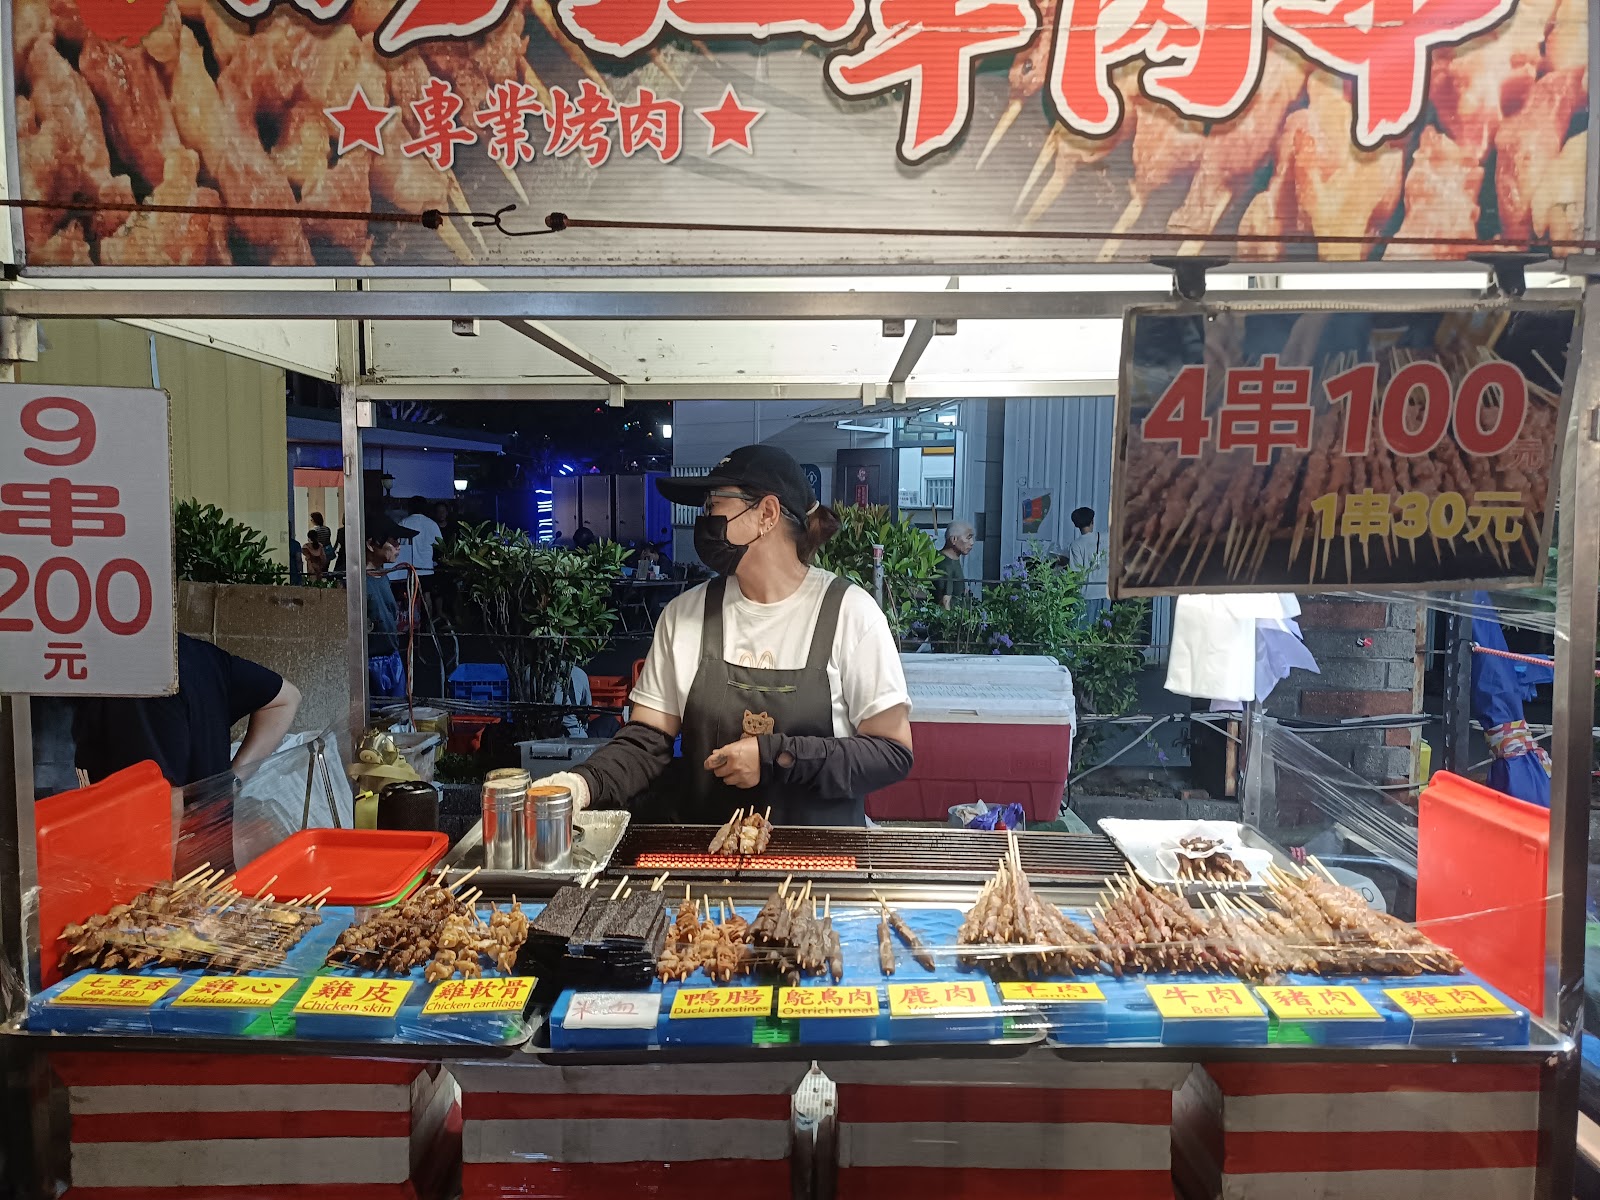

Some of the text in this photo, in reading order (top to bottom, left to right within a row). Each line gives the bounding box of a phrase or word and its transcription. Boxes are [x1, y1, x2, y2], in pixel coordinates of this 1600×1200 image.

[402, 77, 683, 170] 專業烤肉
[20, 396, 96, 466] 9
[0, 477, 126, 547] 串
[1311, 489, 1525, 544] 1串30元
[0, 555, 153, 636] 200
[44, 642, 87, 680] 元
[84, 977, 170, 990] 七里香
[194, 979, 282, 995] 雞心
[312, 980, 398, 1003] 雞皮
[434, 981, 528, 1001] 雞軟骨
[1011, 983, 1089, 994] 羊肉
[182, 995, 270, 1005] Chicken heart
[426, 998, 523, 1011] Chicken cartilage
[683, 988, 765, 1006] 鴨腸
[785, 987, 873, 1006] 鴕鳥肉
[899, 985, 977, 1005] 鹿肉
[1163, 986, 1243, 1005] 牛肉
[1271, 986, 1357, 1006] 豬肉
[1404, 987, 1488, 1006] 雞肉
[301, 1000, 392, 1013] Chicken skin
[705, 1005, 769, 1013] intestines
[782, 1006, 875, 1014] Ostrich meat
[1191, 1005, 1230, 1015] Beef
[1306, 1006, 1347, 1016] Pork
[1423, 1005, 1495, 1015] Chicken
